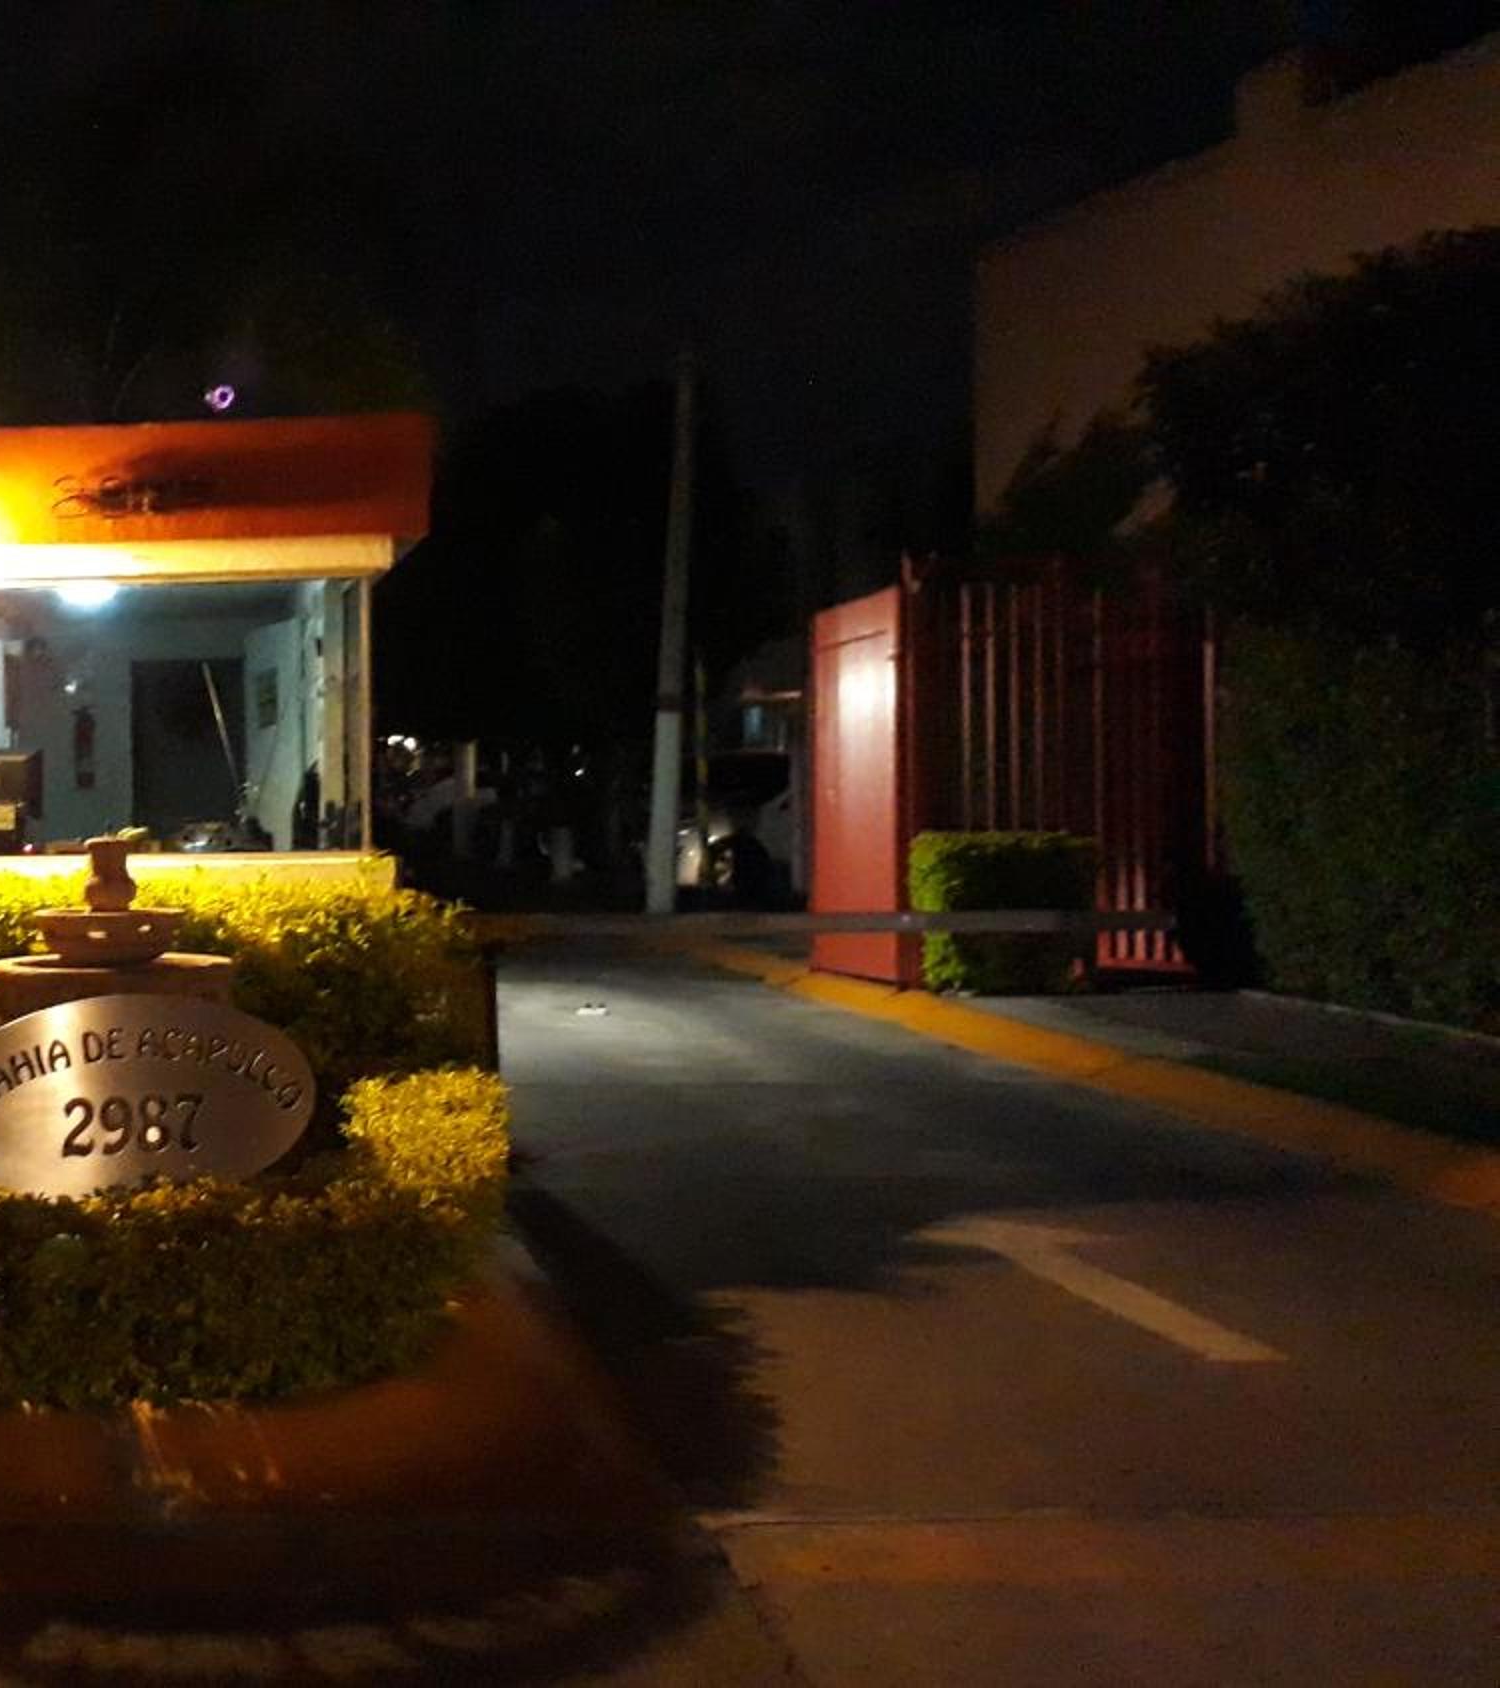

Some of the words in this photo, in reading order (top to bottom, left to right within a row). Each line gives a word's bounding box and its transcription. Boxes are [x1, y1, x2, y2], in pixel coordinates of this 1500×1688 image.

[82, 1028, 124, 1063] DE
[137, 1026, 304, 1110] ACAPULCO
[61, 1094, 205, 1157] 2987
